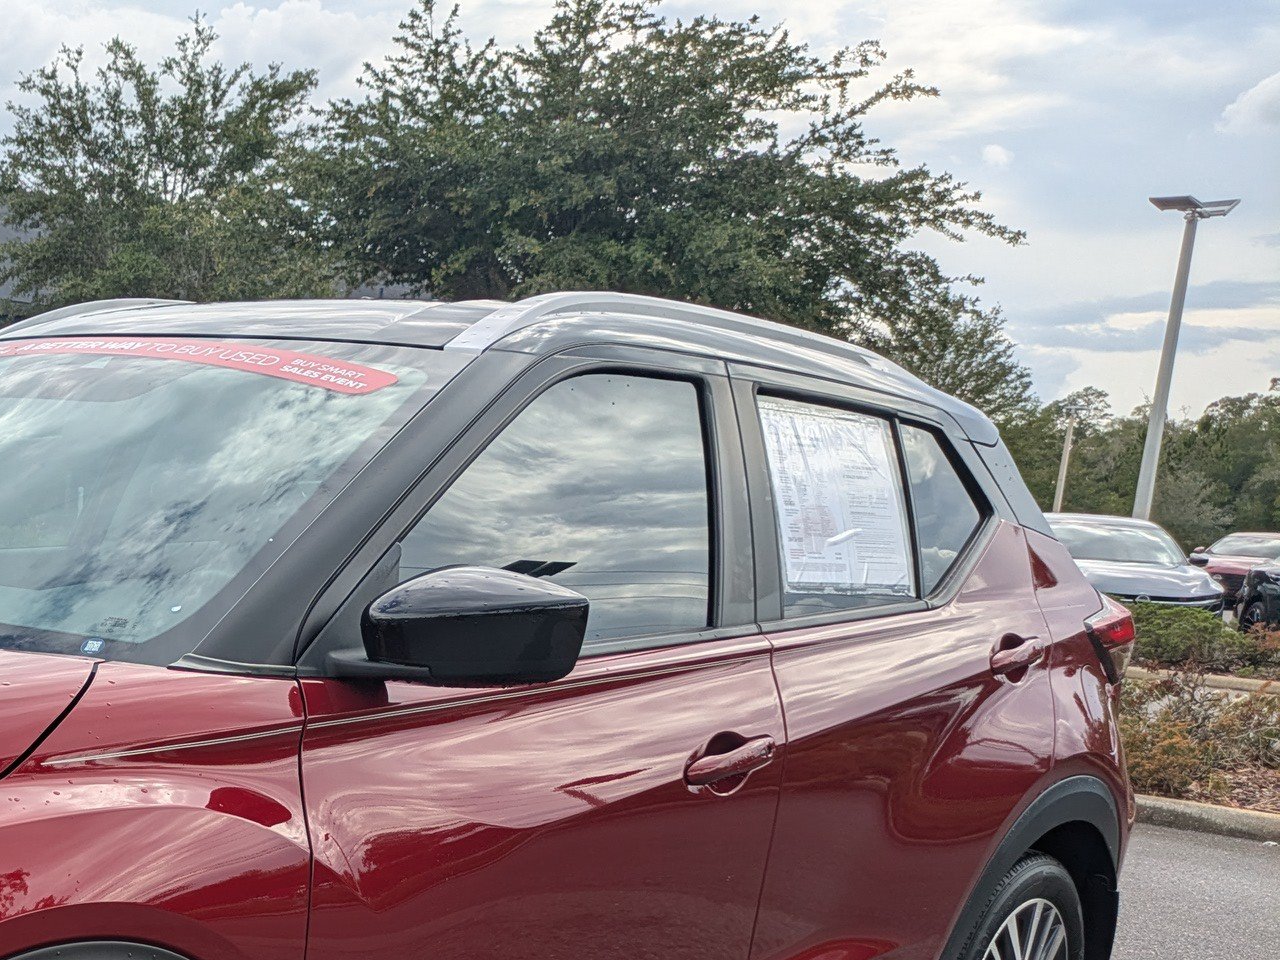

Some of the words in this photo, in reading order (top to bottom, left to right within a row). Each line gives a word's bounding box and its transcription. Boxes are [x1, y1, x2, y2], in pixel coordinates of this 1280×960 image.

[17, 343, 35, 351] A
[32, 341, 104, 350] BETTER
[101, 341, 150, 350] WAY
[147, 342, 177, 352] TO
[174, 345, 224, 356] BUY
[219, 349, 280, 366] USED
[279, 364, 322, 378] SALES
[320, 374, 367, 389] EVENT
[291, 358, 320, 368] BUY
[317, 364, 365, 378] SMART
